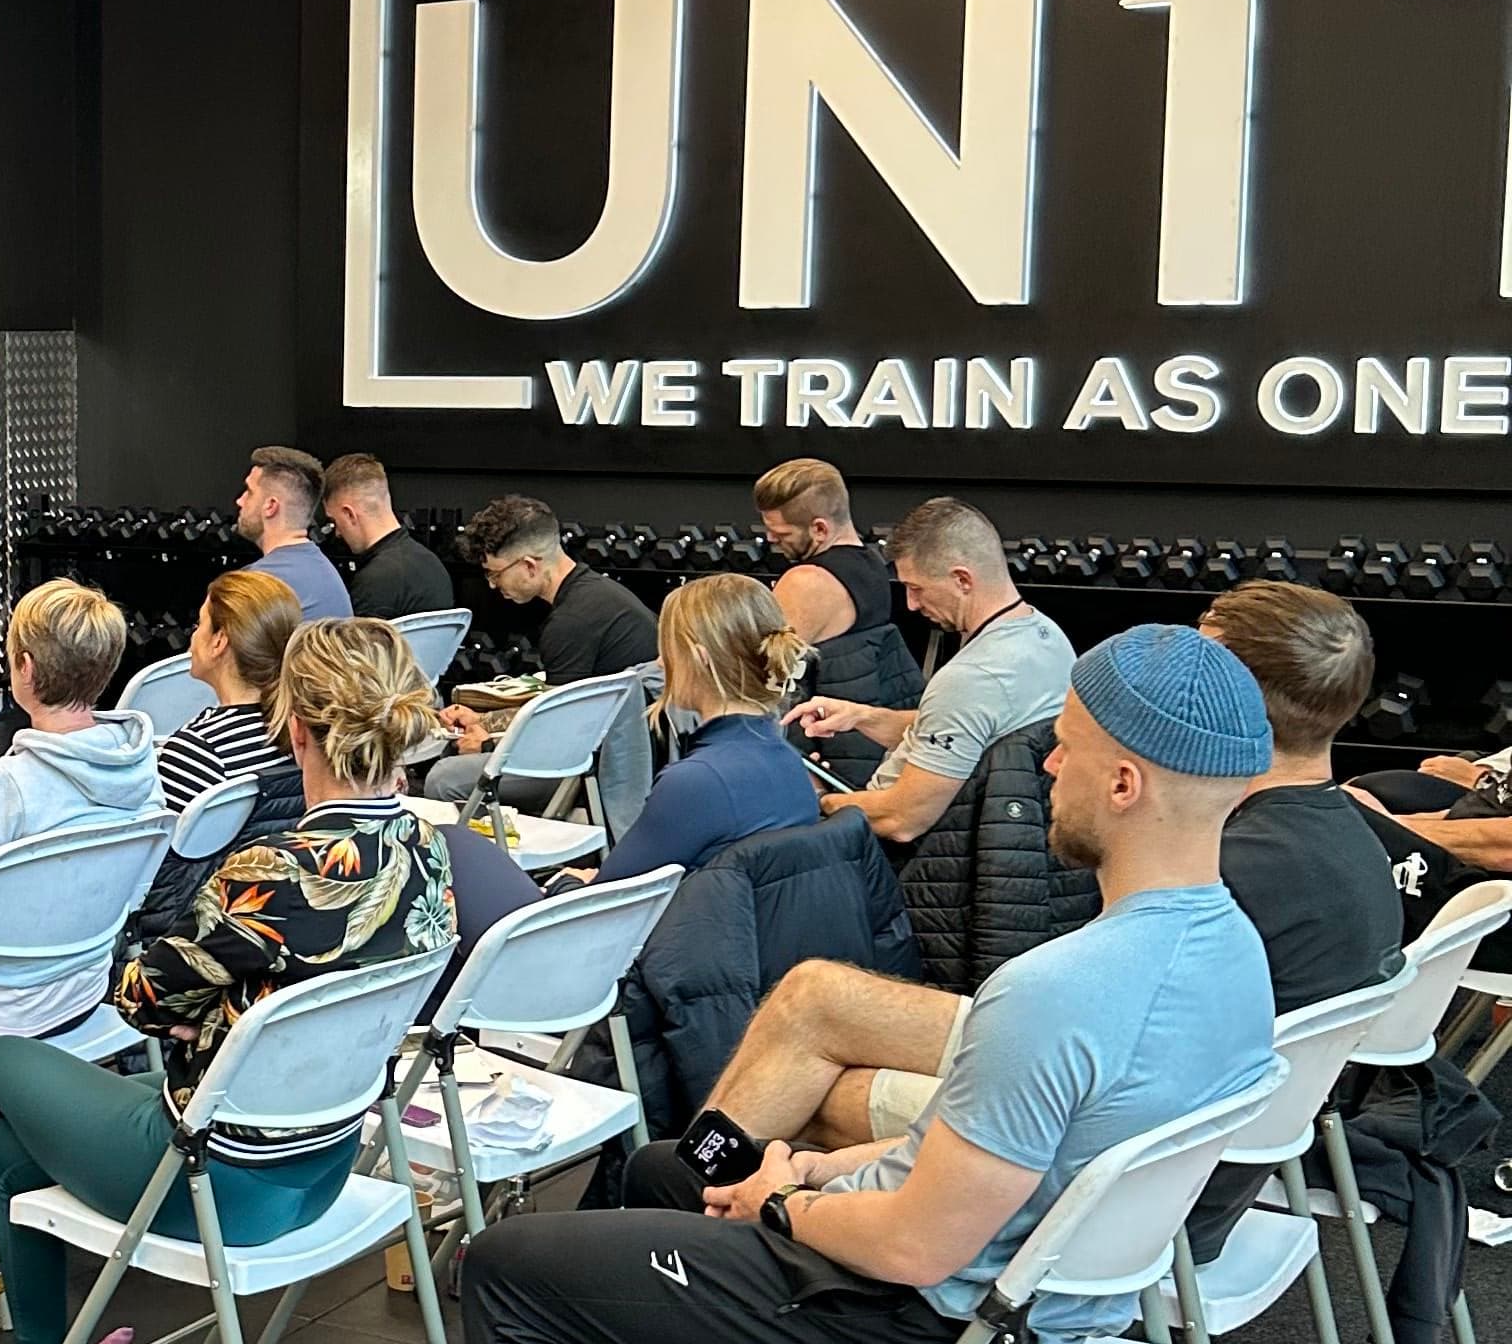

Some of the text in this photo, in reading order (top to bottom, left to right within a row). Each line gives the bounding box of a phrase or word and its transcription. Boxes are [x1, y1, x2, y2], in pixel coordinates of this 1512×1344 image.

[543, 354, 1511, 436] WE TRAIN AS ONE
[220, 554, 229, 566] 7
[697, 1132, 726, 1163] 16:33
